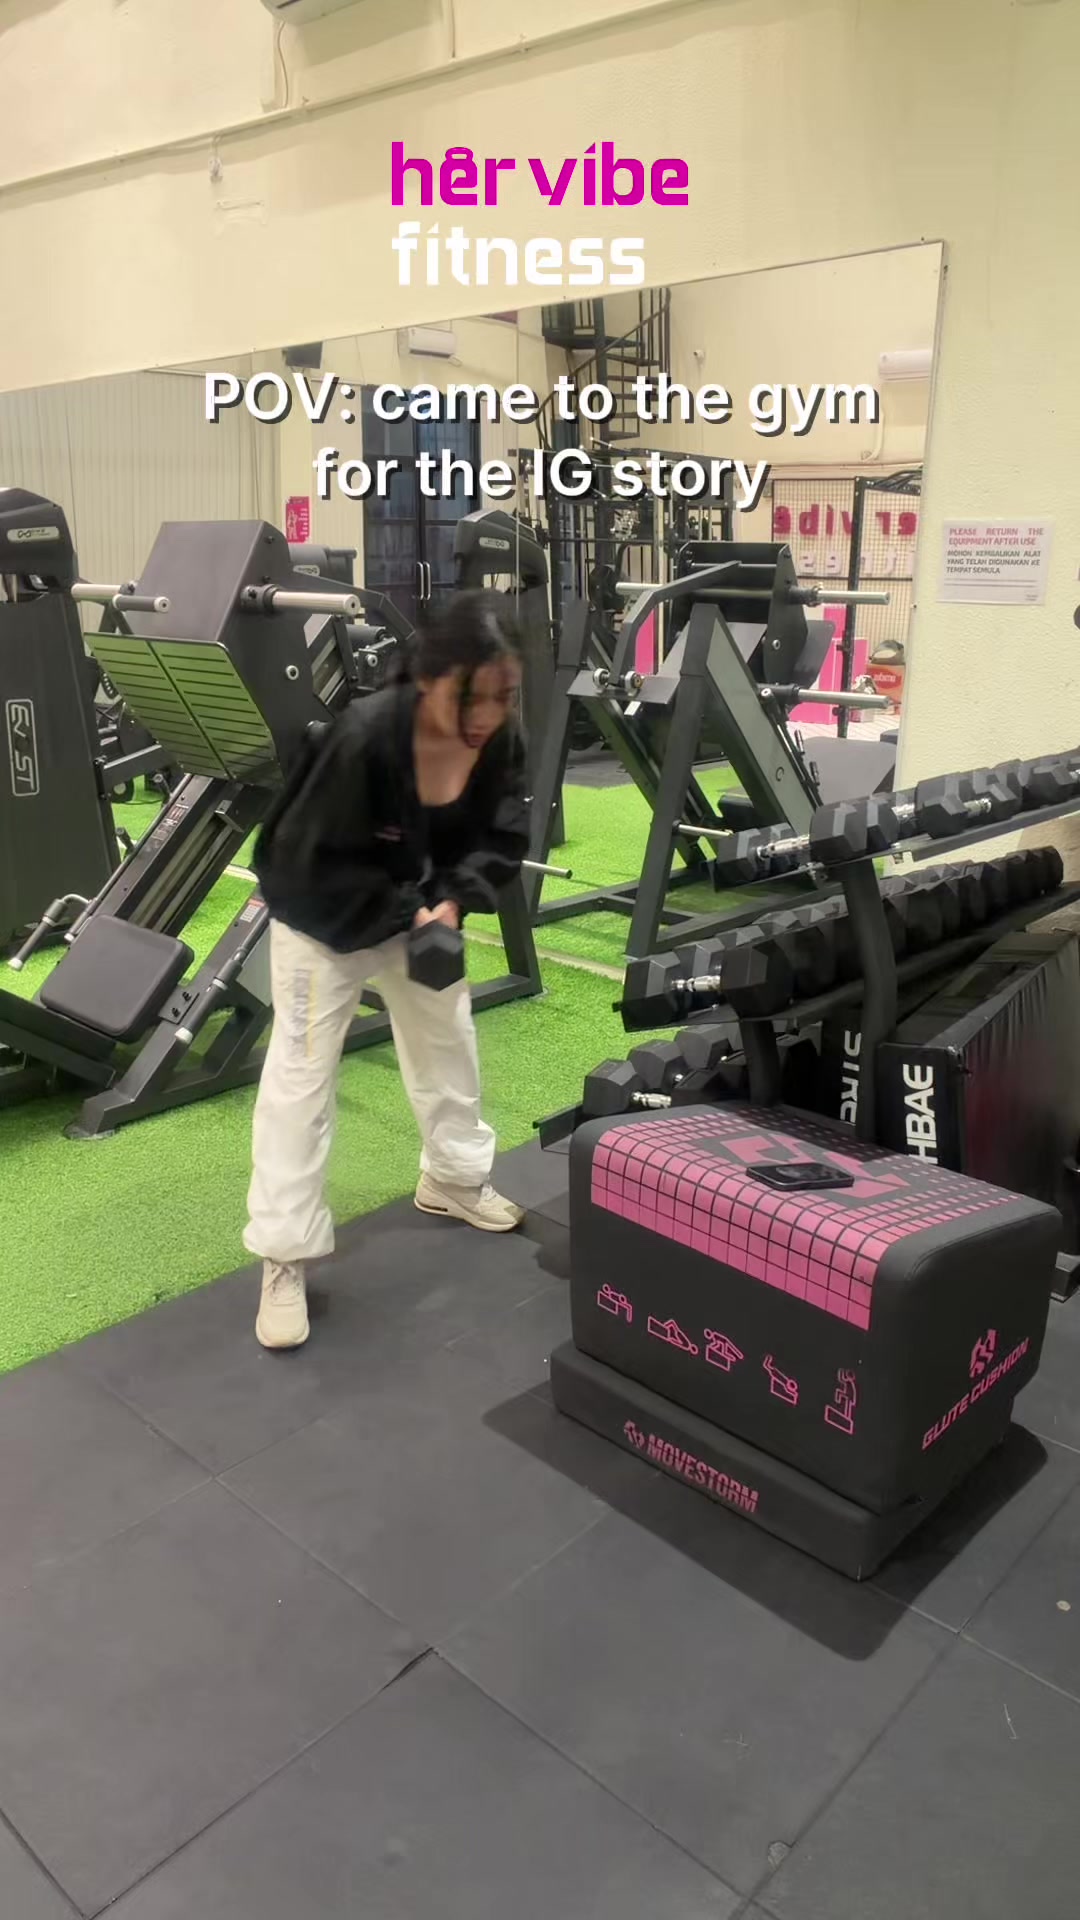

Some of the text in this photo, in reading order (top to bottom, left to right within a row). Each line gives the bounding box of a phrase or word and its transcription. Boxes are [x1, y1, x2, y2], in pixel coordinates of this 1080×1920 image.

[949, 527, 1044, 536] PLEASE RETURN THE
[949, 537, 1036, 547] EQUIPMENT AFTER USE
[946, 566, 972, 574] TEMPAT
[922, 1337, 1031, 1450] GLUTE CUSHION
[647, 1433, 760, 1513] MOVESTORM
